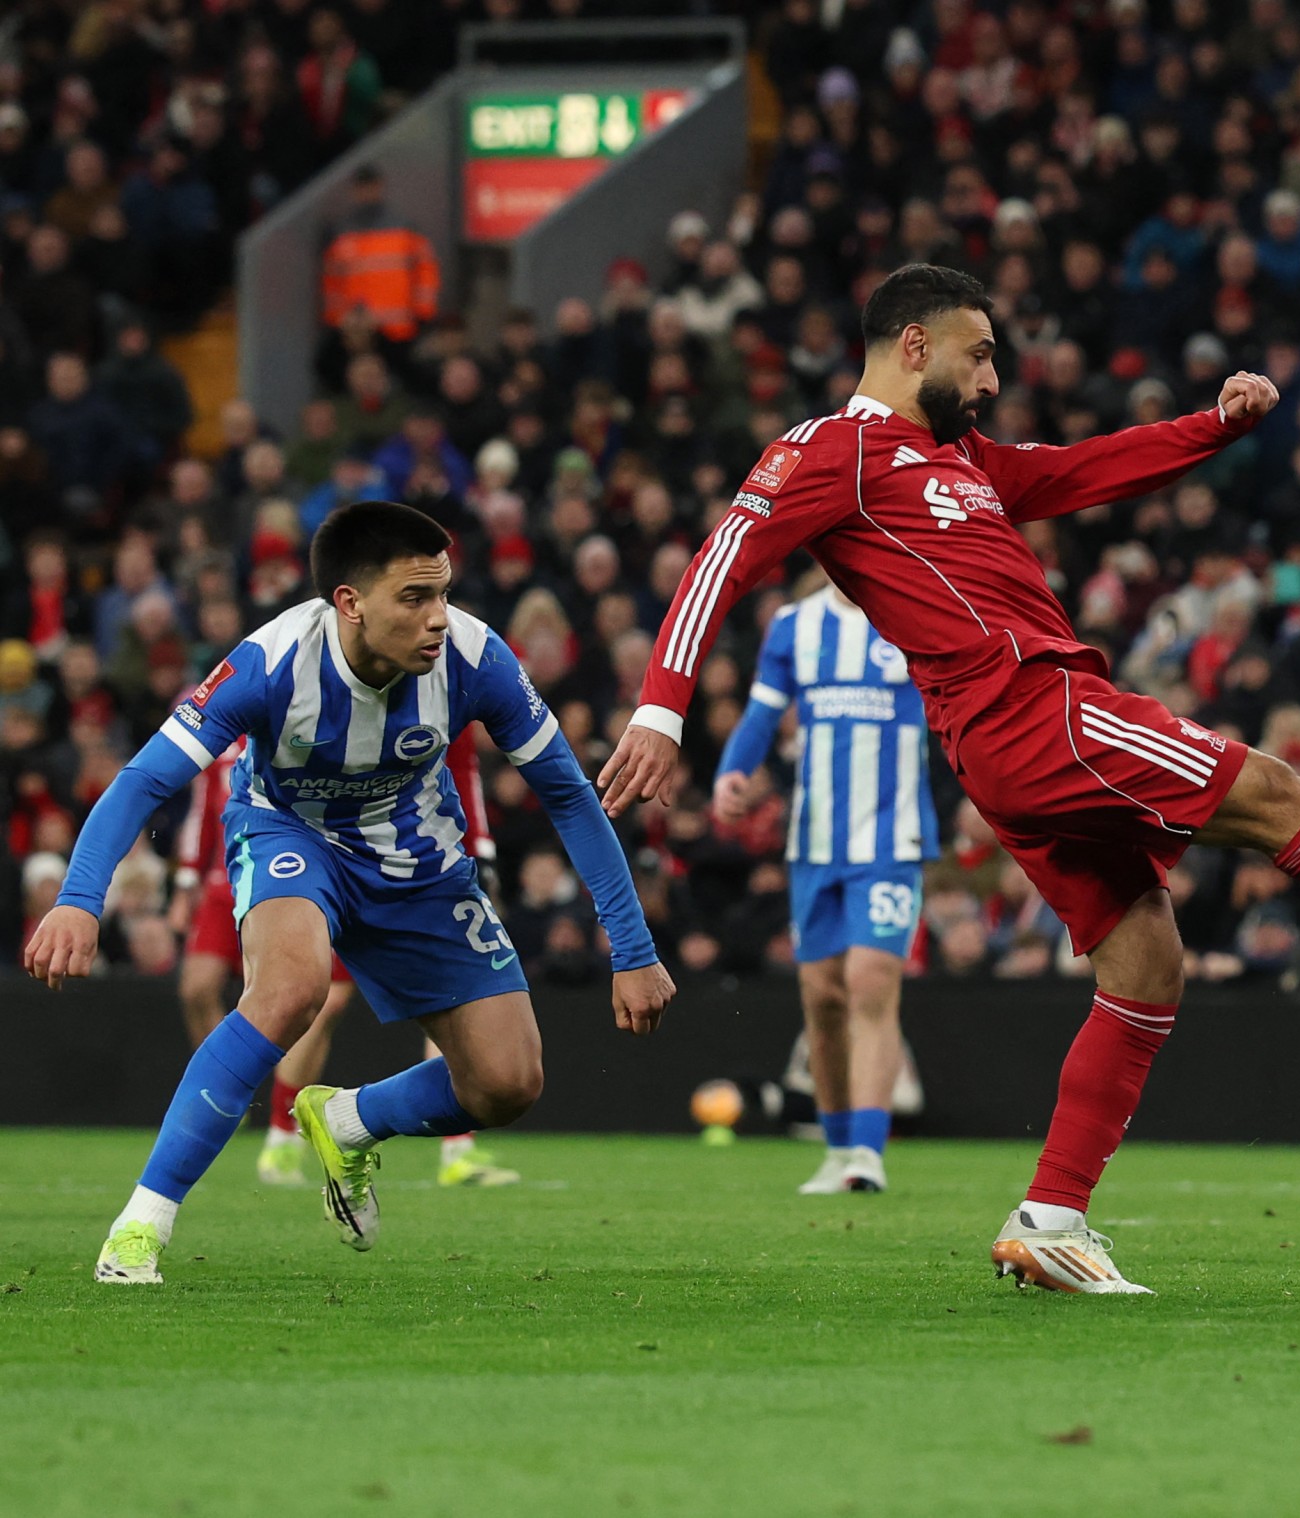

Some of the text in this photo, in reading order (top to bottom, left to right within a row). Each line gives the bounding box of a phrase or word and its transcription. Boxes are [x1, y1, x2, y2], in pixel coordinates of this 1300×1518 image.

[470, 104, 554, 149] EXIT
[760, 477, 778, 487] CUP
[744, 493, 770, 509] room
[868, 881, 914, 929] 53
